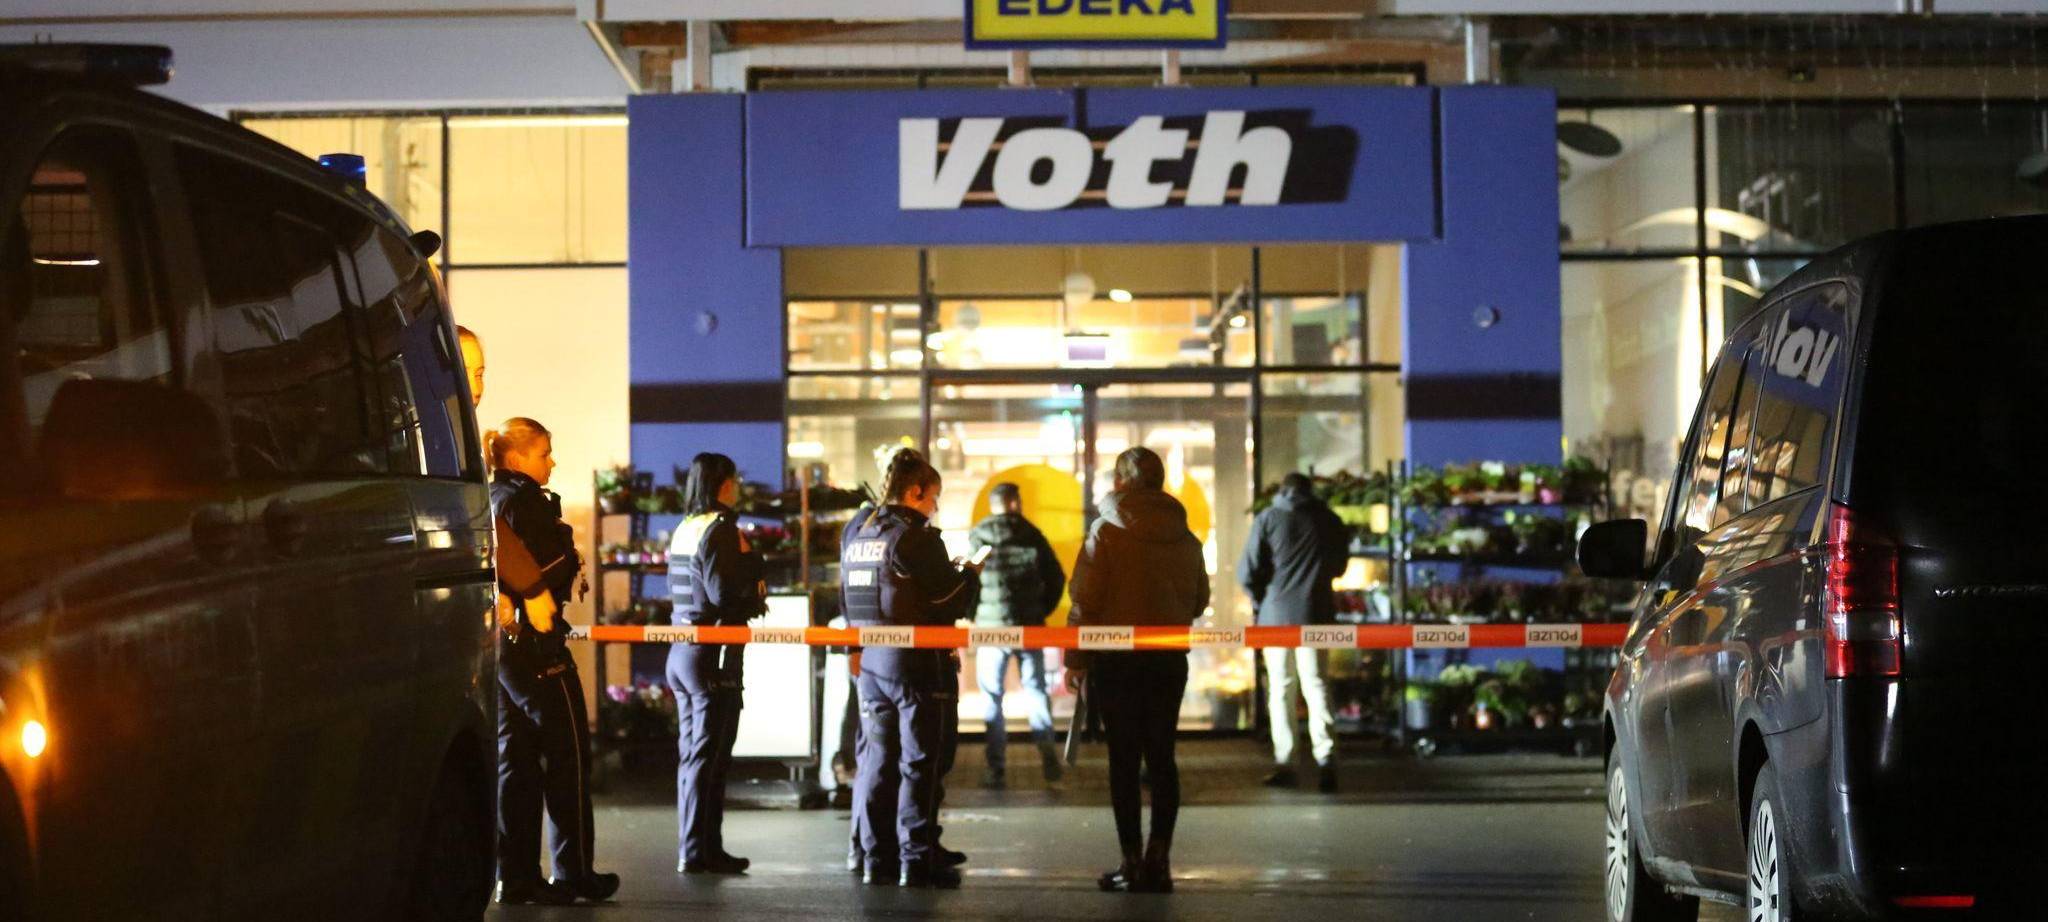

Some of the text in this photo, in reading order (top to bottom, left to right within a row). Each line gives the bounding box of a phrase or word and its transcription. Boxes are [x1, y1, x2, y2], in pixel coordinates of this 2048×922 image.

[898, 110, 1293, 211] Voth
[845, 541, 887, 562] POLIZEI
[647, 630, 1578, 644] POLIZEI POLIZEI POLIZEI POLIZEI POLIZEI POLIZEI POLIZEI POLIZEI POLIZEI
